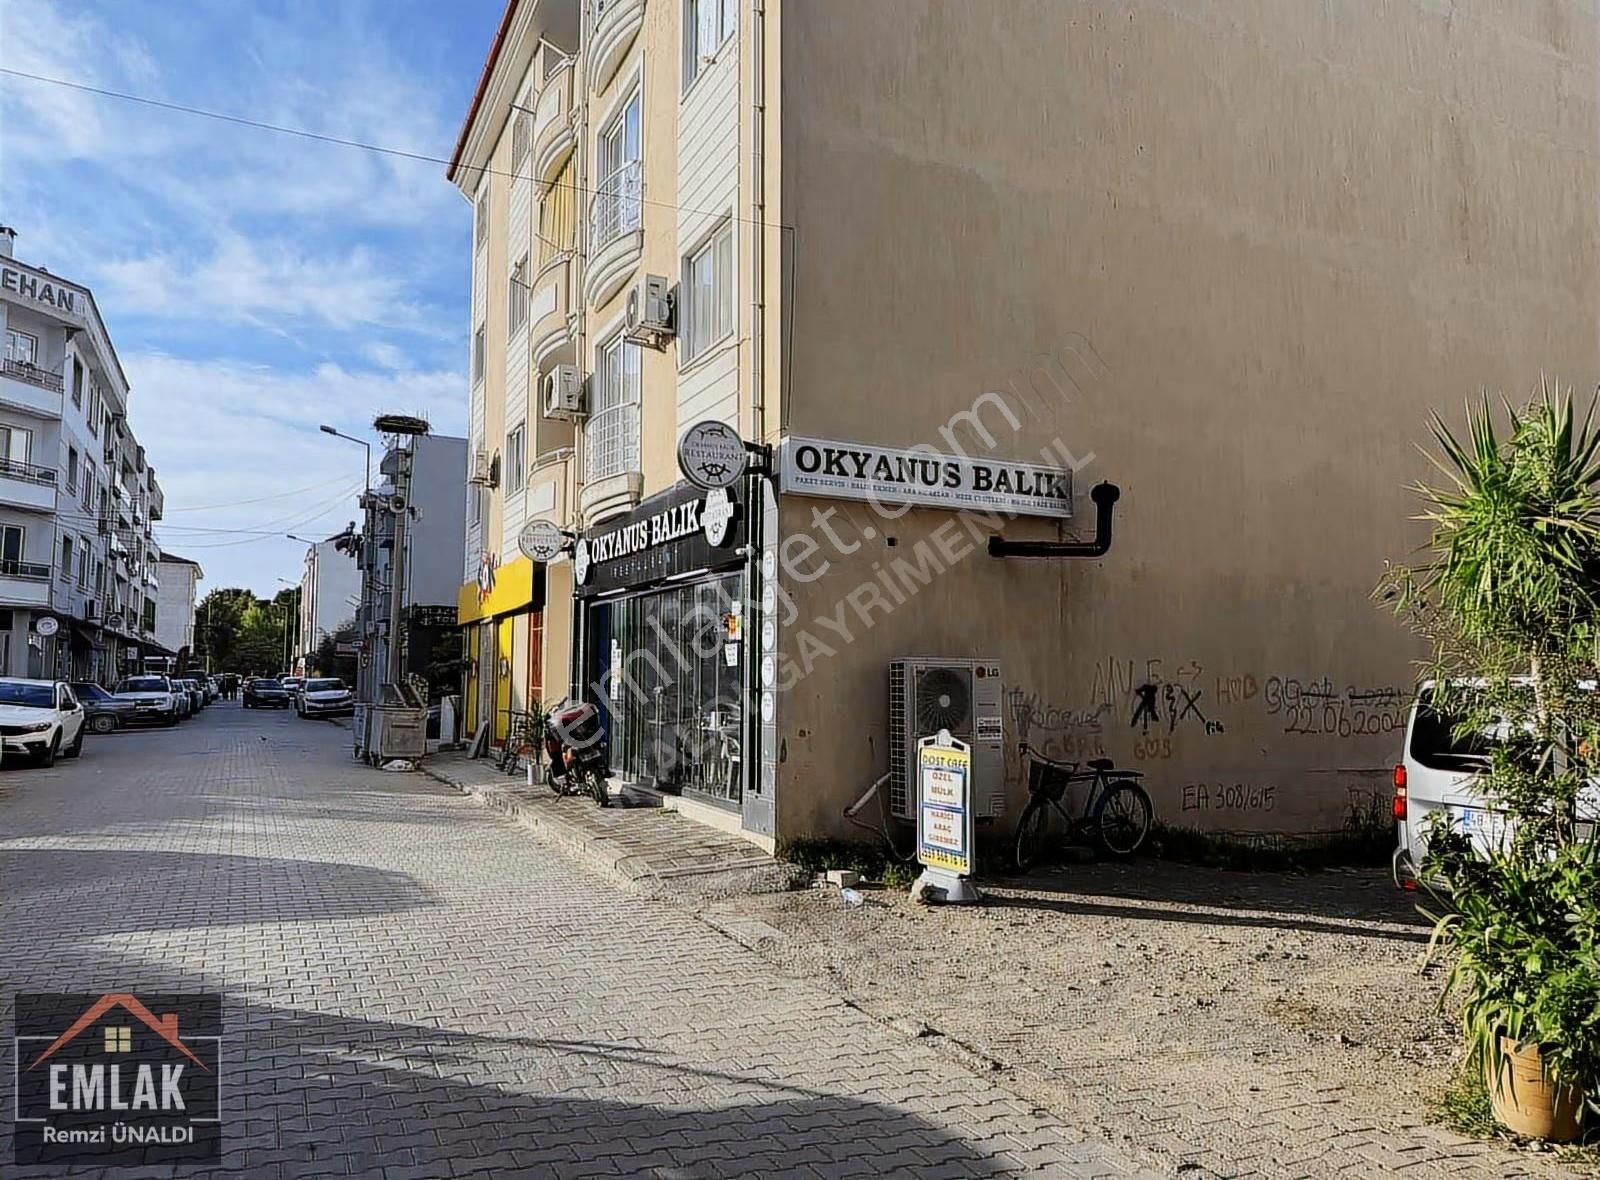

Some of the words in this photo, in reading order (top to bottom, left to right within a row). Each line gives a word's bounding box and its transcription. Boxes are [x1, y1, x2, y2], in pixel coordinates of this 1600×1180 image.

[2, 268, 75, 312] EHAN
[795, 445, 961, 488] OKYANUS
[972, 465, 1068, 500] BALIK
[591, 519, 648, 564] OKYANUS
[651, 499, 700, 547] BALIK
[987, 667, 999, 677] LG
